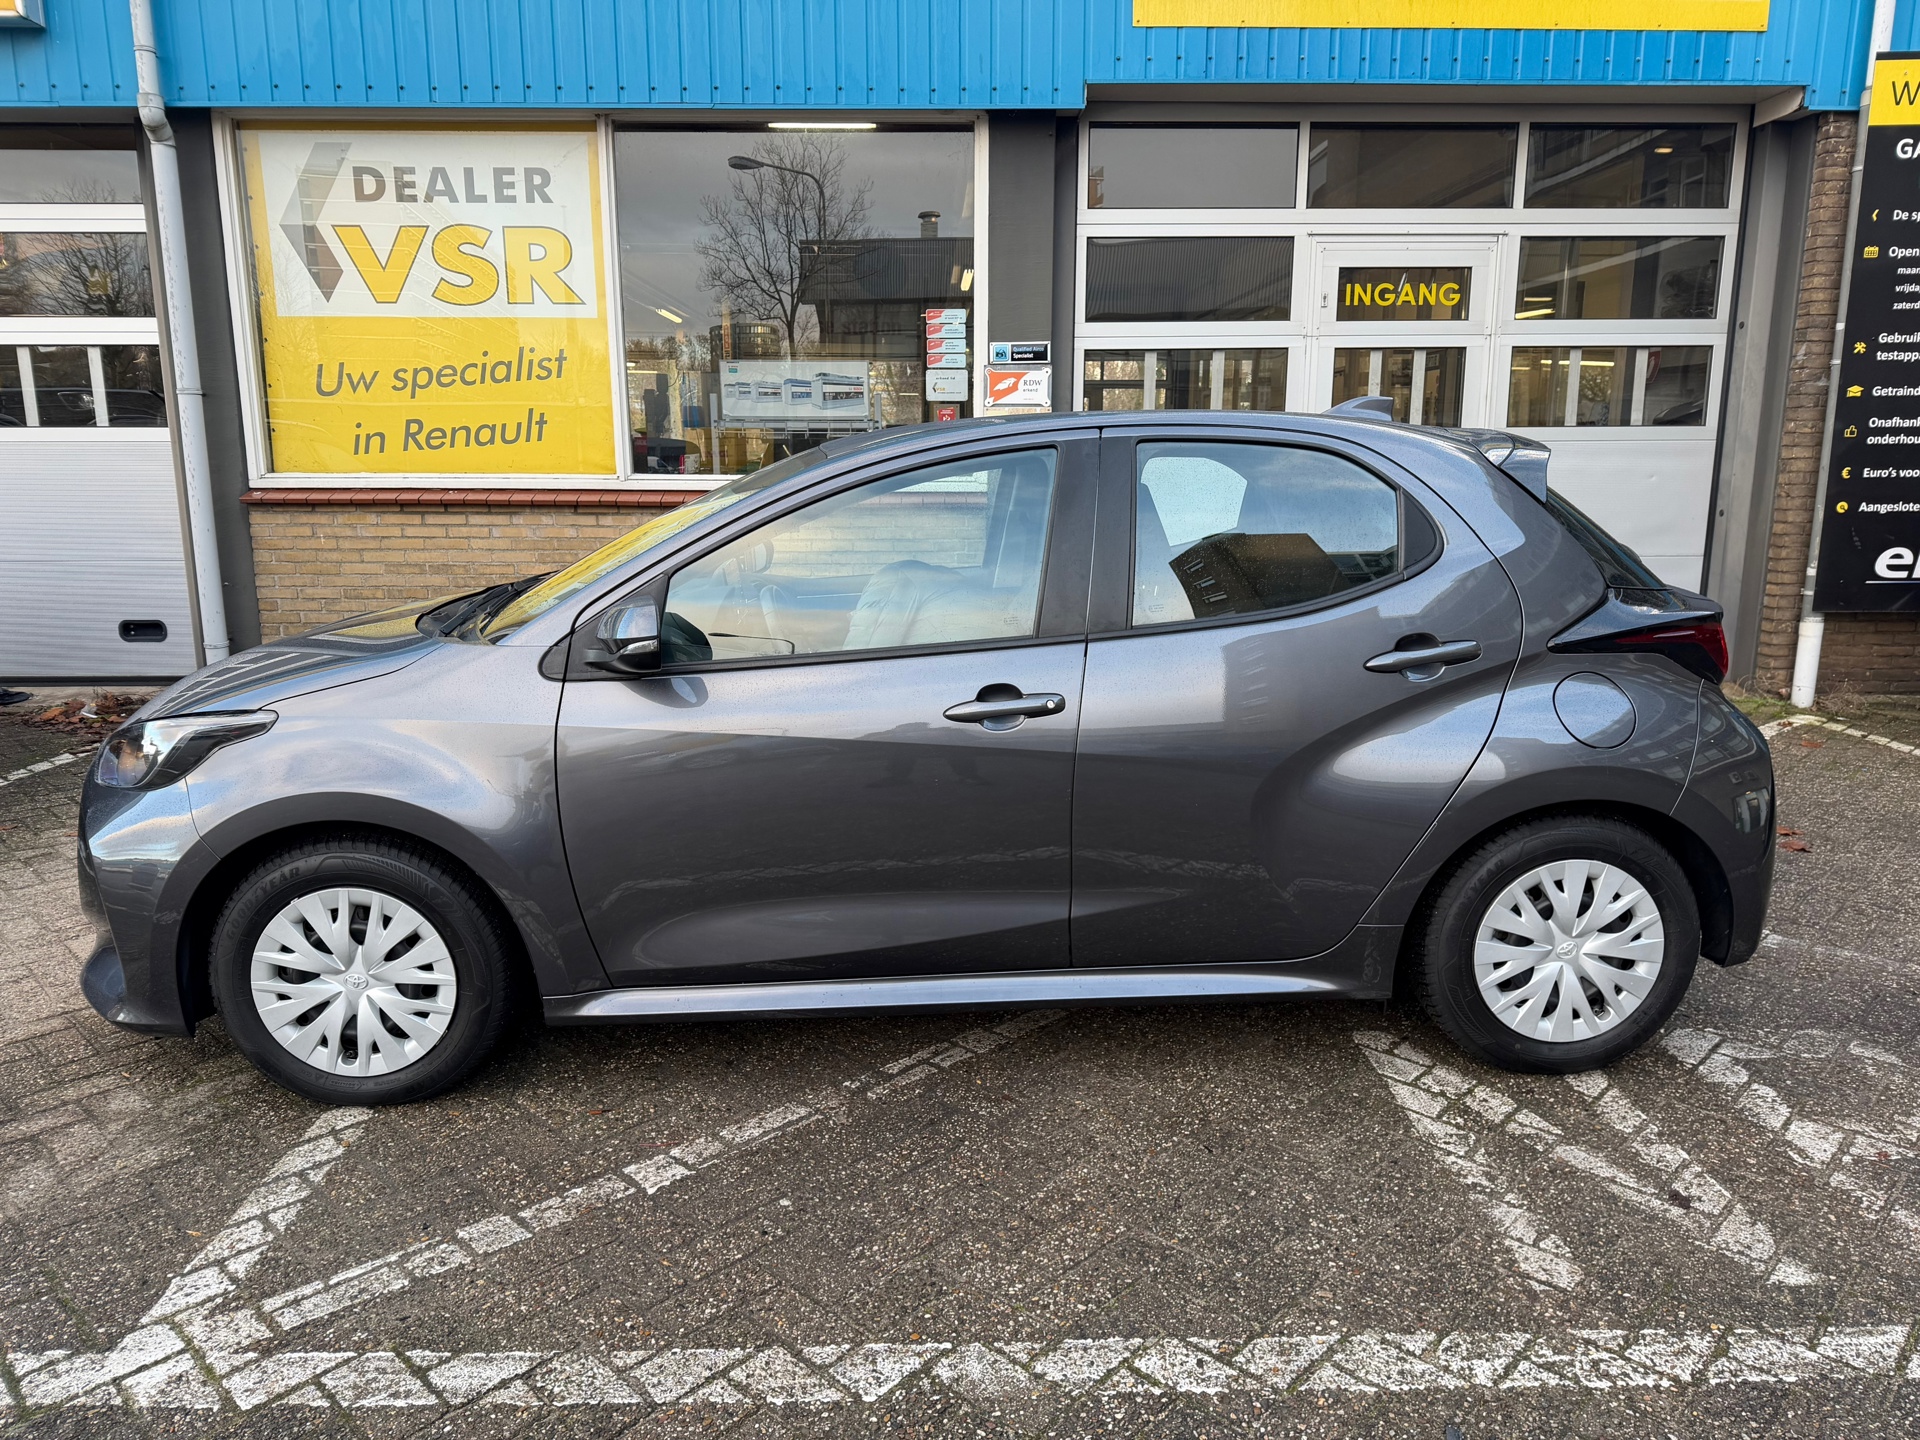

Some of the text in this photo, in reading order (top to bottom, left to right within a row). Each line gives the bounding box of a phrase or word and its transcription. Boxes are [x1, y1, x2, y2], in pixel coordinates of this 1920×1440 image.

[351, 165, 554, 204] DEALER
[1893, 209, 1909, 220] De
[331, 223, 587, 306] VSR
[1345, 282, 1461, 307] INGANG
[1895, 282, 1920, 293] vrijda
[1876, 350, 1920, 363] testapp
[315, 346, 568, 400] Uw specialist
[1023, 379, 1043, 387] RDW
[353, 407, 549, 456] in Renault
[1863, 467, 1897, 478] Euro's
[1874, 546, 1920, 579] e
